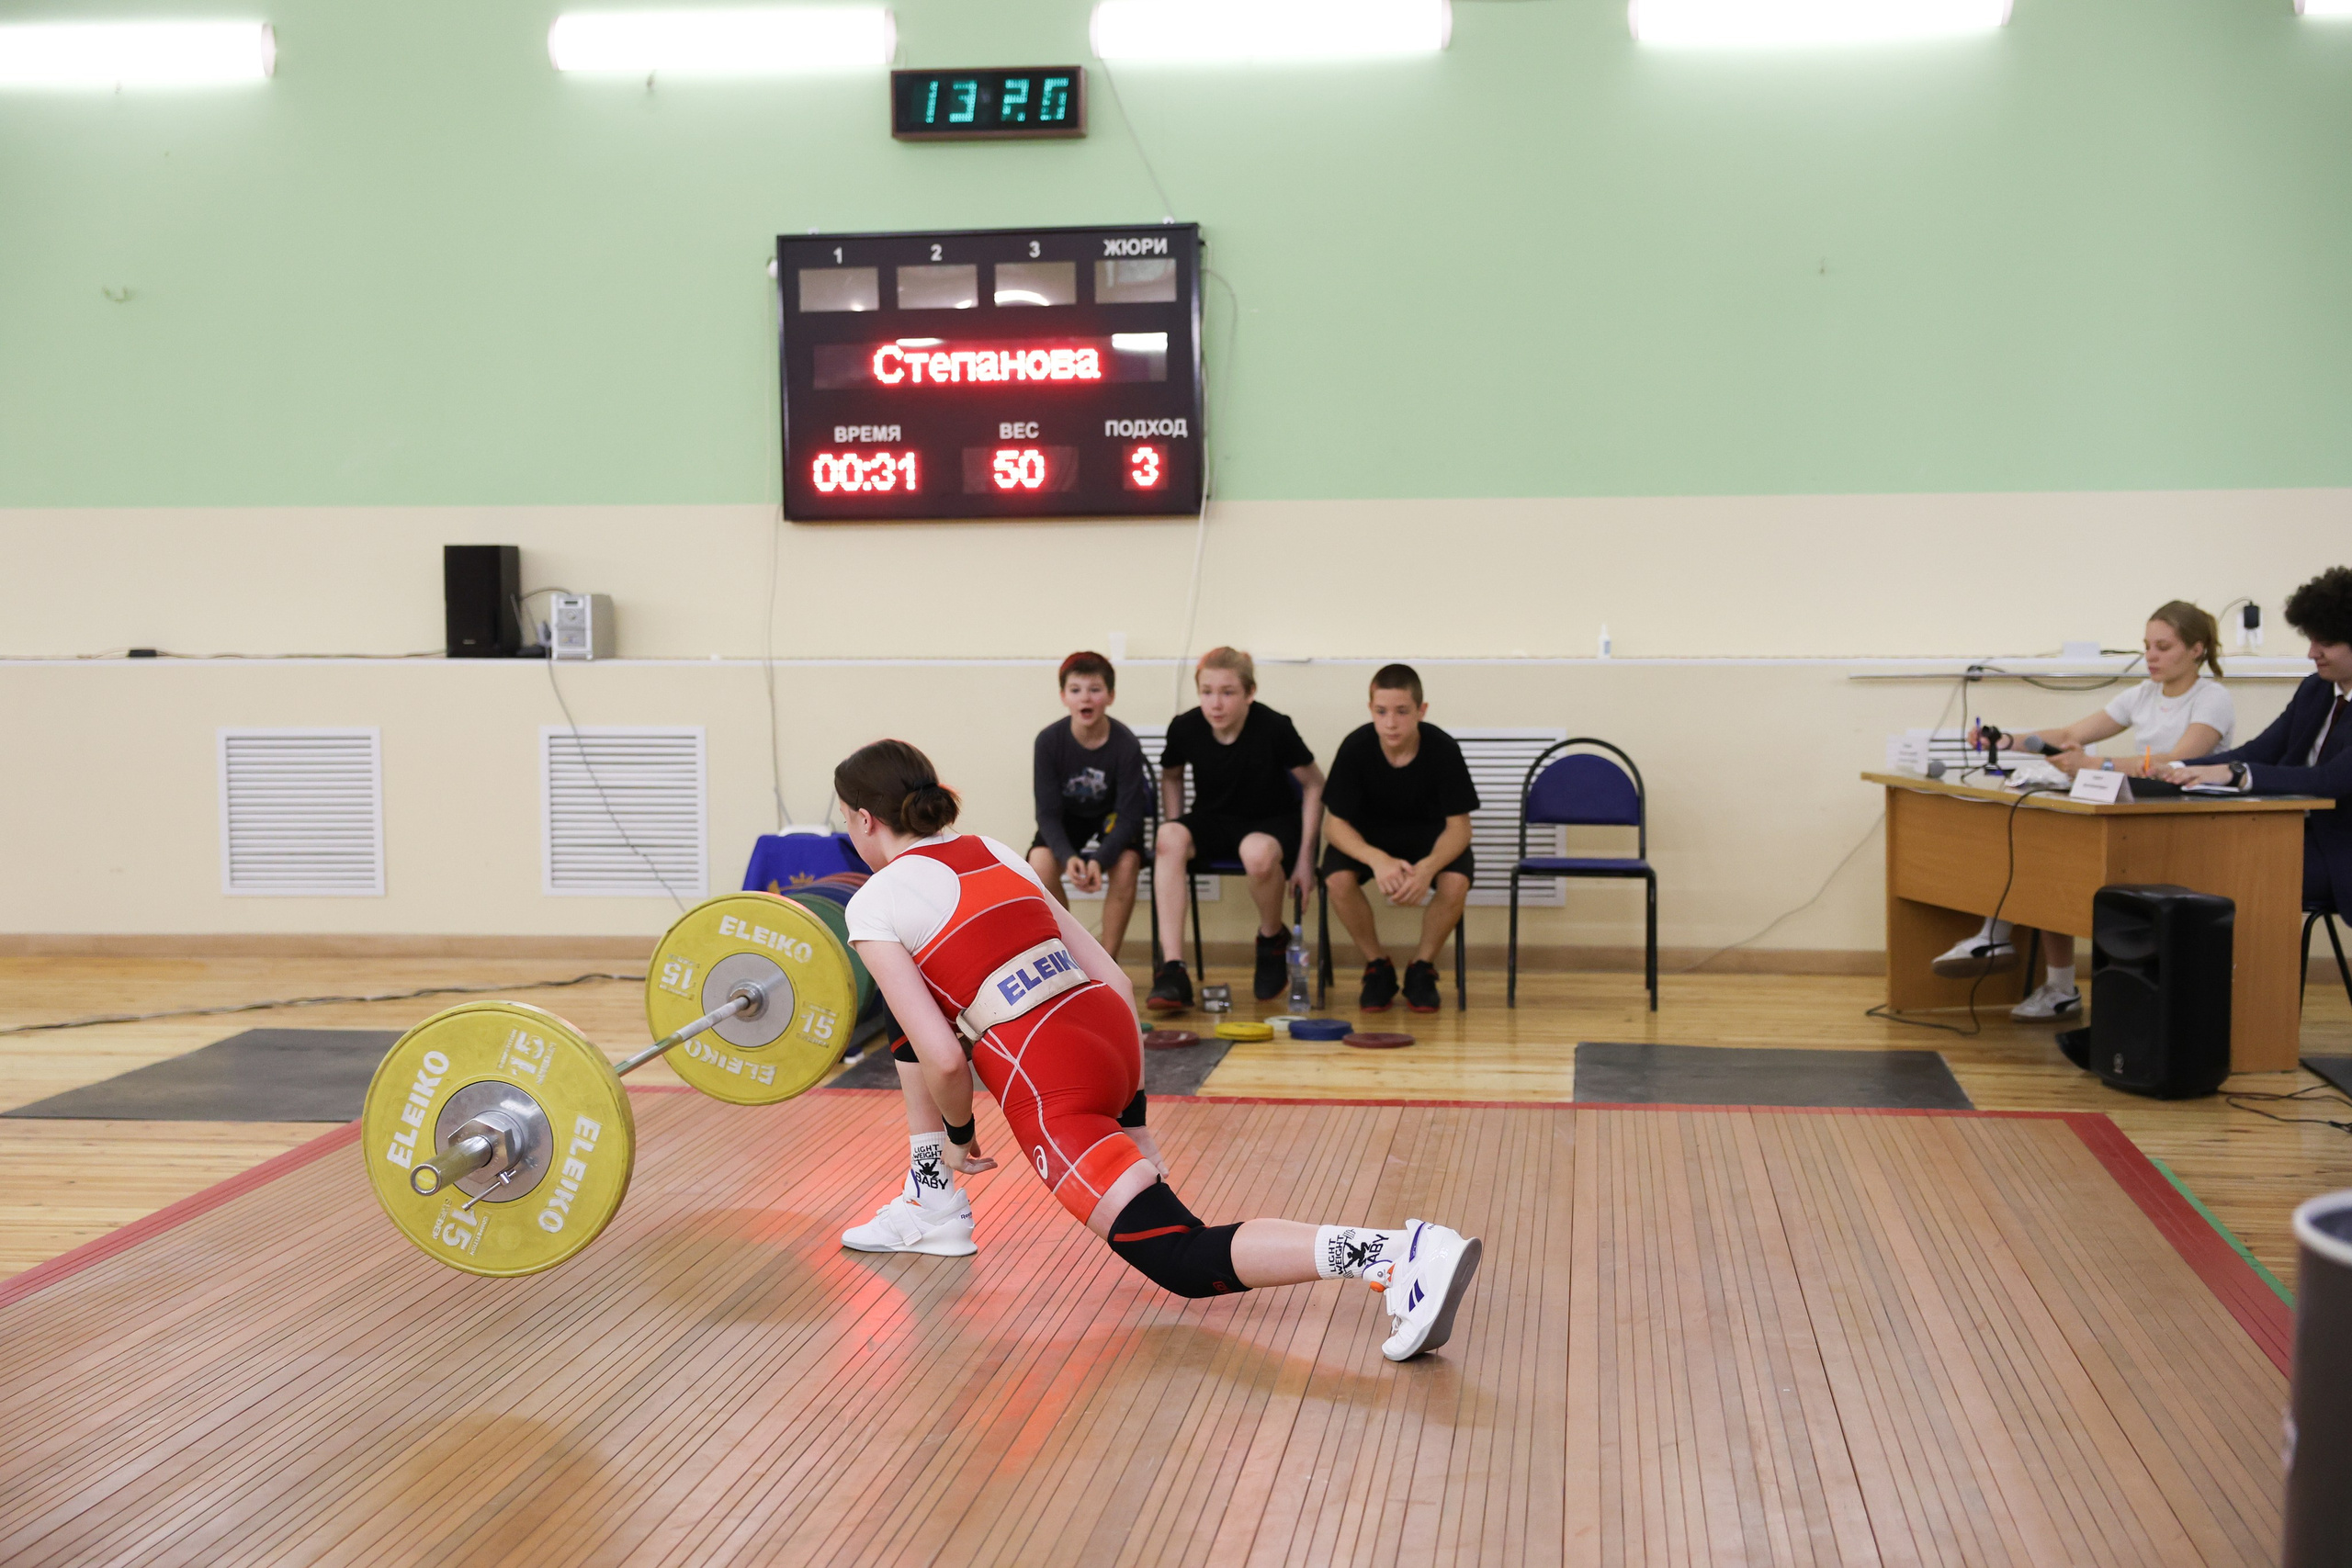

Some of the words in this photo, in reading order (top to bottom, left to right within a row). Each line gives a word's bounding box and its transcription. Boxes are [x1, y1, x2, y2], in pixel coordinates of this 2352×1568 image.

[833, 247, 842, 264] 1
[931, 244, 943, 261] 2
[1029, 241, 1041, 258] 3
[1103, 238, 1168, 256] ЖЮРИ
[873, 344, 1102, 384] Степанова
[834, 425, 902, 443] ВРЕМЯ
[999, 422, 1040, 439] ВЕС
[1104, 418, 1188, 438] ПОДХОД
[812, 452, 916, 492] 00:31
[993, 449, 1046, 489] 50
[1131, 446, 1159, 486] 3
[718, 914, 813, 964] ELEIKO
[662, 962, 695, 990] 15
[997, 950, 1080, 1007] ELEIK
[800, 1011, 836, 1039] 15
[510, 1031, 545, 1076] 15
[684, 1036, 779, 1087] ELEIKO
[386, 1050, 450, 1169] ELEIKO
[912, 1150, 943, 1159] WEIGHT
[914, 1145, 939, 1154] LIGHT
[537, 1114, 601, 1234] ELEIKO
[915, 1171, 948, 1190] BABY
[442, 1208, 478, 1250] 15
[1328, 1238, 1336, 1272] LIGHT
[1334, 1234, 1344, 1275] WEIGHT
[1366, 1234, 1389, 1265] ABY
